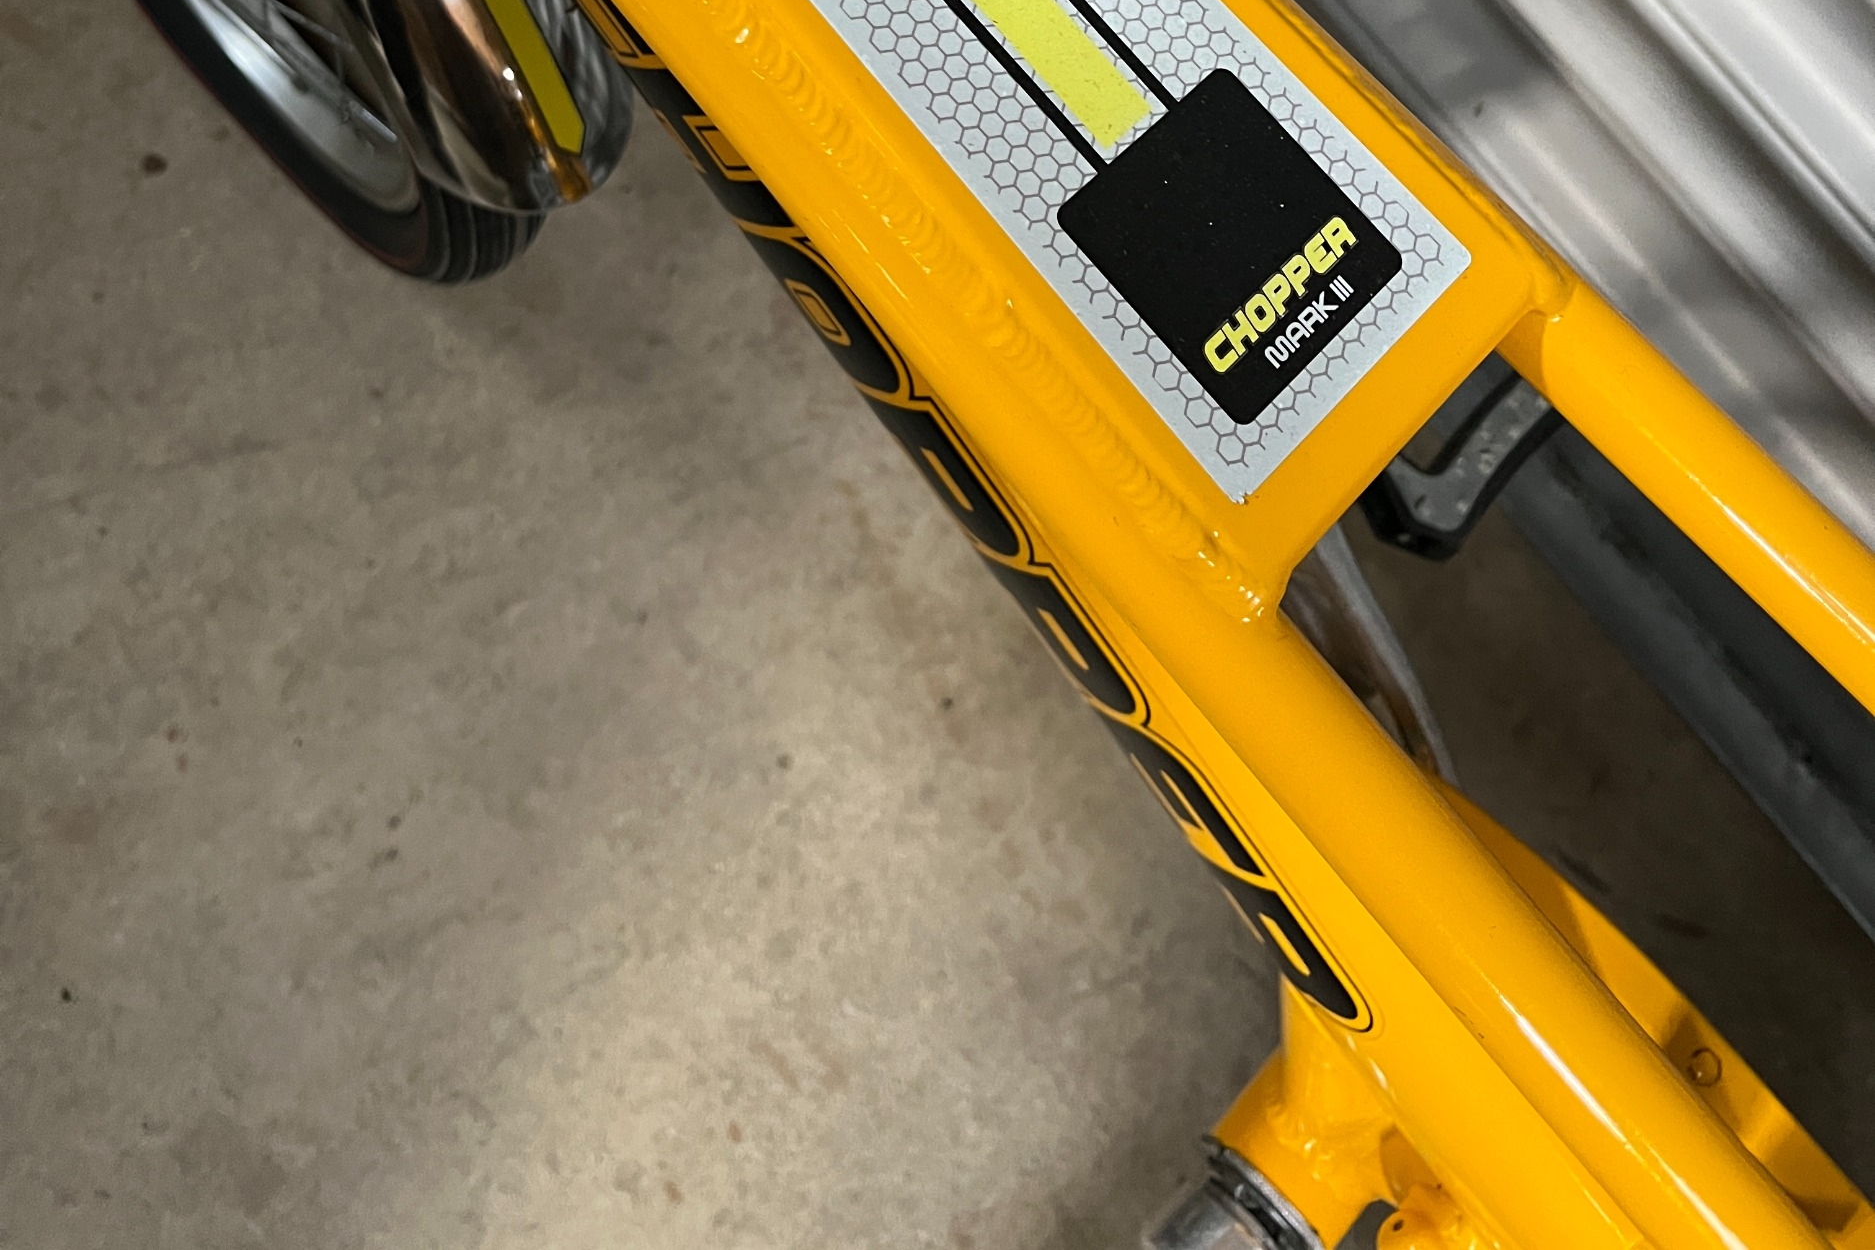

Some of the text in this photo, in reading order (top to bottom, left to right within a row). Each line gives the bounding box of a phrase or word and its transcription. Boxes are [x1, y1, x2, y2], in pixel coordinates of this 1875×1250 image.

[1203, 215, 1359, 375] CHOPPER
[1263, 274, 1355, 369] MARK III
